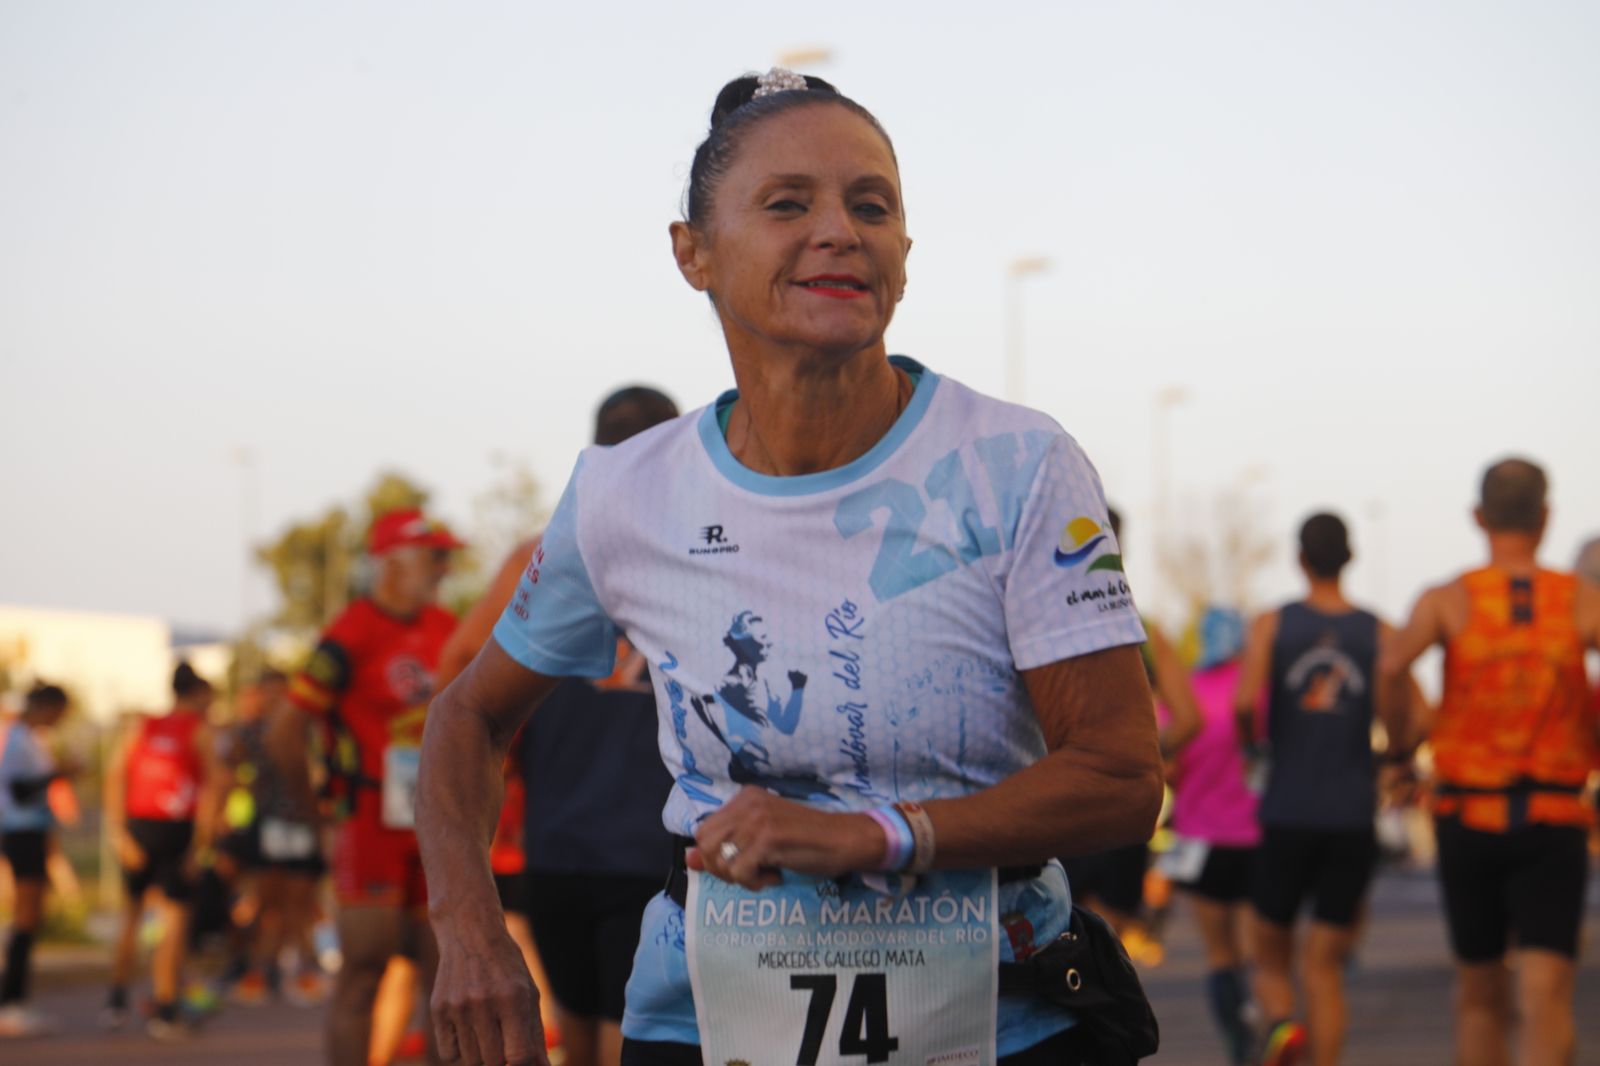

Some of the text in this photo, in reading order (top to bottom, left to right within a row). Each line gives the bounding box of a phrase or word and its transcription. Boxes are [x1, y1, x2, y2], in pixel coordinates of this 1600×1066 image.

[825, 598, 865, 640] Río
[829, 650, 860, 690] del
[703, 890, 986, 928] MEDIA MARATÓN
[915, 929, 947, 945] DEL
[955, 925, 988, 945] RÍO
[758, 949, 925, 970] MERCEDES GALLEGO MATA
[790, 973, 898, 1066] 74
